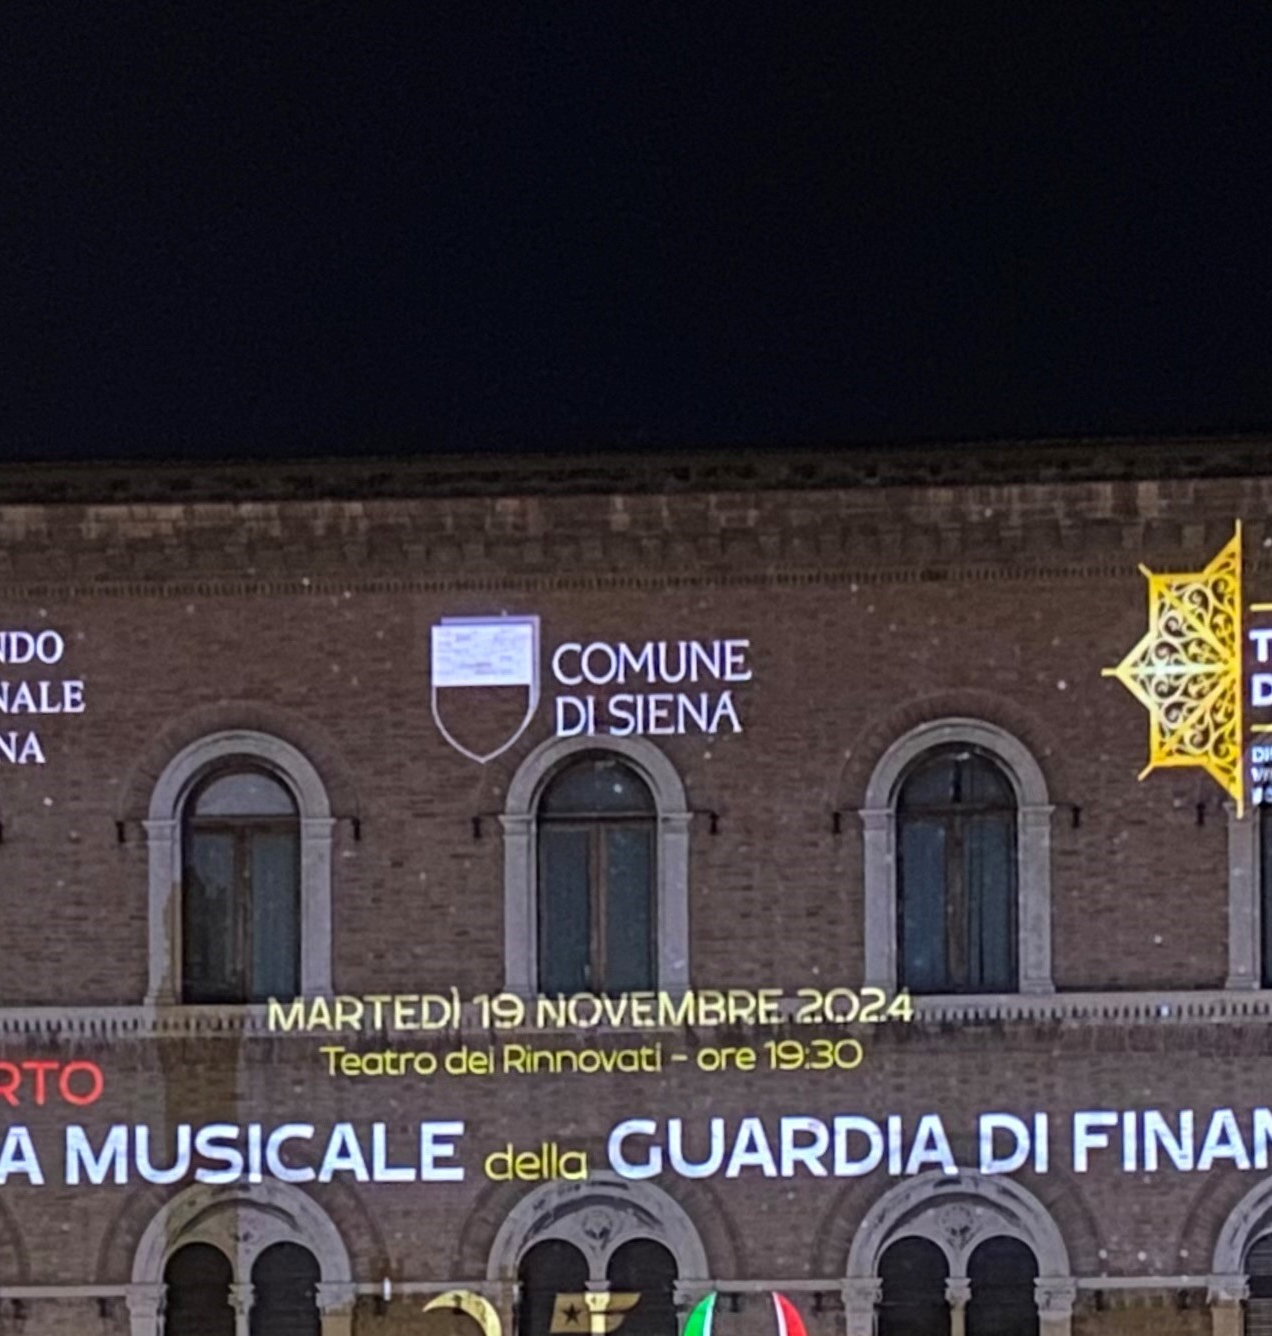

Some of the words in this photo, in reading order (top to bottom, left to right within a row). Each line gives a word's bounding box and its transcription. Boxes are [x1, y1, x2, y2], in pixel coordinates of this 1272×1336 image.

[551, 639, 753, 686] COMUNE
[555, 695, 596, 737] DI
[608, 690, 743, 737] SIENA
[267, 986, 462, 1032] MARTEDÌ
[472, 993, 526, 1029] 19
[536, 988, 785, 1029] NOVEMBRE
[796, 986, 915, 1024] 2024
[319, 1045, 438, 1077] Teatro
[444, 1045, 496, 1076] dei
[503, 1042, 663, 1073] Rinnovati
[696, 1047, 757, 1071] ore
[764, 1038, 864, 1070] 19:30
[63, 1121, 466, 1186] MUSICALE
[484, 1146, 588, 1182] della
[607, 1113, 957, 1180] GUARDIA
[978, 1112, 1049, 1174] DI
